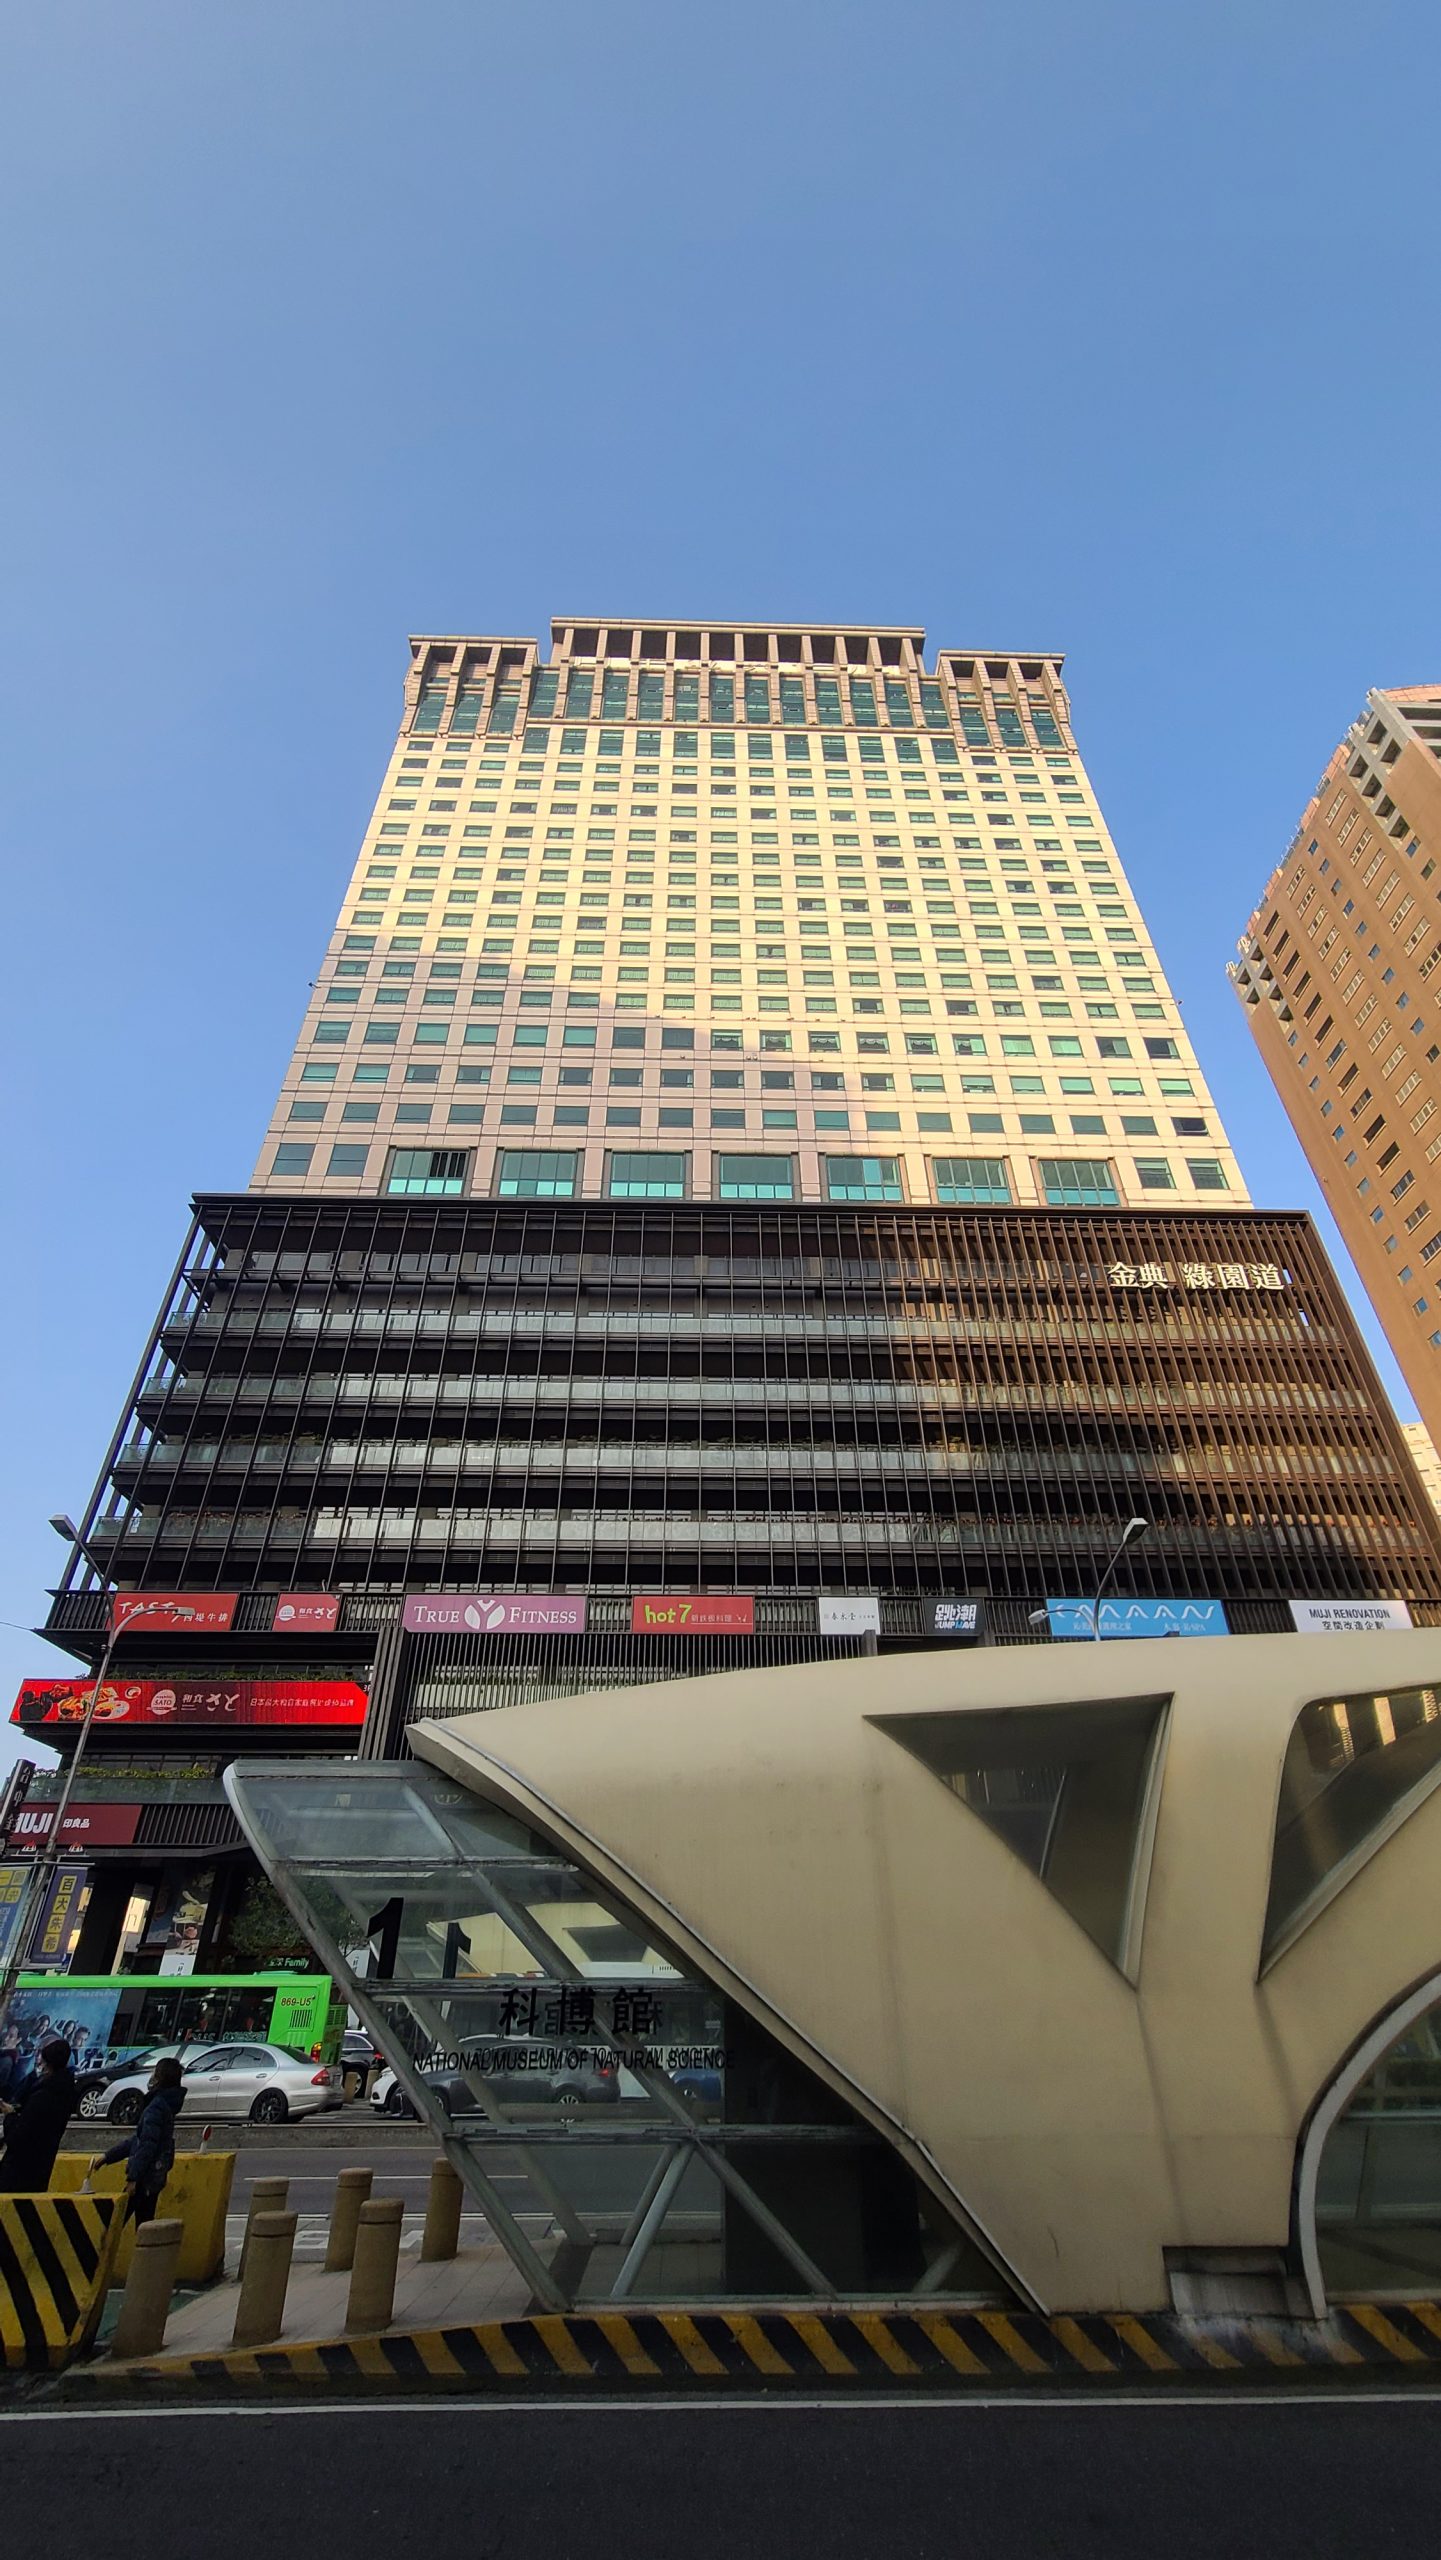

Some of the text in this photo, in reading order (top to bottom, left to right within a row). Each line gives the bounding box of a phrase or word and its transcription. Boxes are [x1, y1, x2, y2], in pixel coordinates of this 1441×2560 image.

[1107, 1262, 1284, 1290] 金典 綠園道
[119, 1601, 180, 1623] TAST
[414, 1606, 577, 1624] TRUE FITNESS
[644, 1604, 692, 1624] hot 7
[1309, 1609, 1391, 1618] MUJI RENOVATION
[62, 1818, 91, 1829] 印良品
[367, 1897, 404, 1979] 1
[499, 1987, 654, 2036] 科博館
[412, 2051, 489, 2071] NATIONAL
[493, 2049, 563, 2070] MUSEUM
[567, 2050, 588, 2069] OF
[593, 2050, 663, 2069] NATURAL
[666, 2050, 735, 2069] SCIENCE
